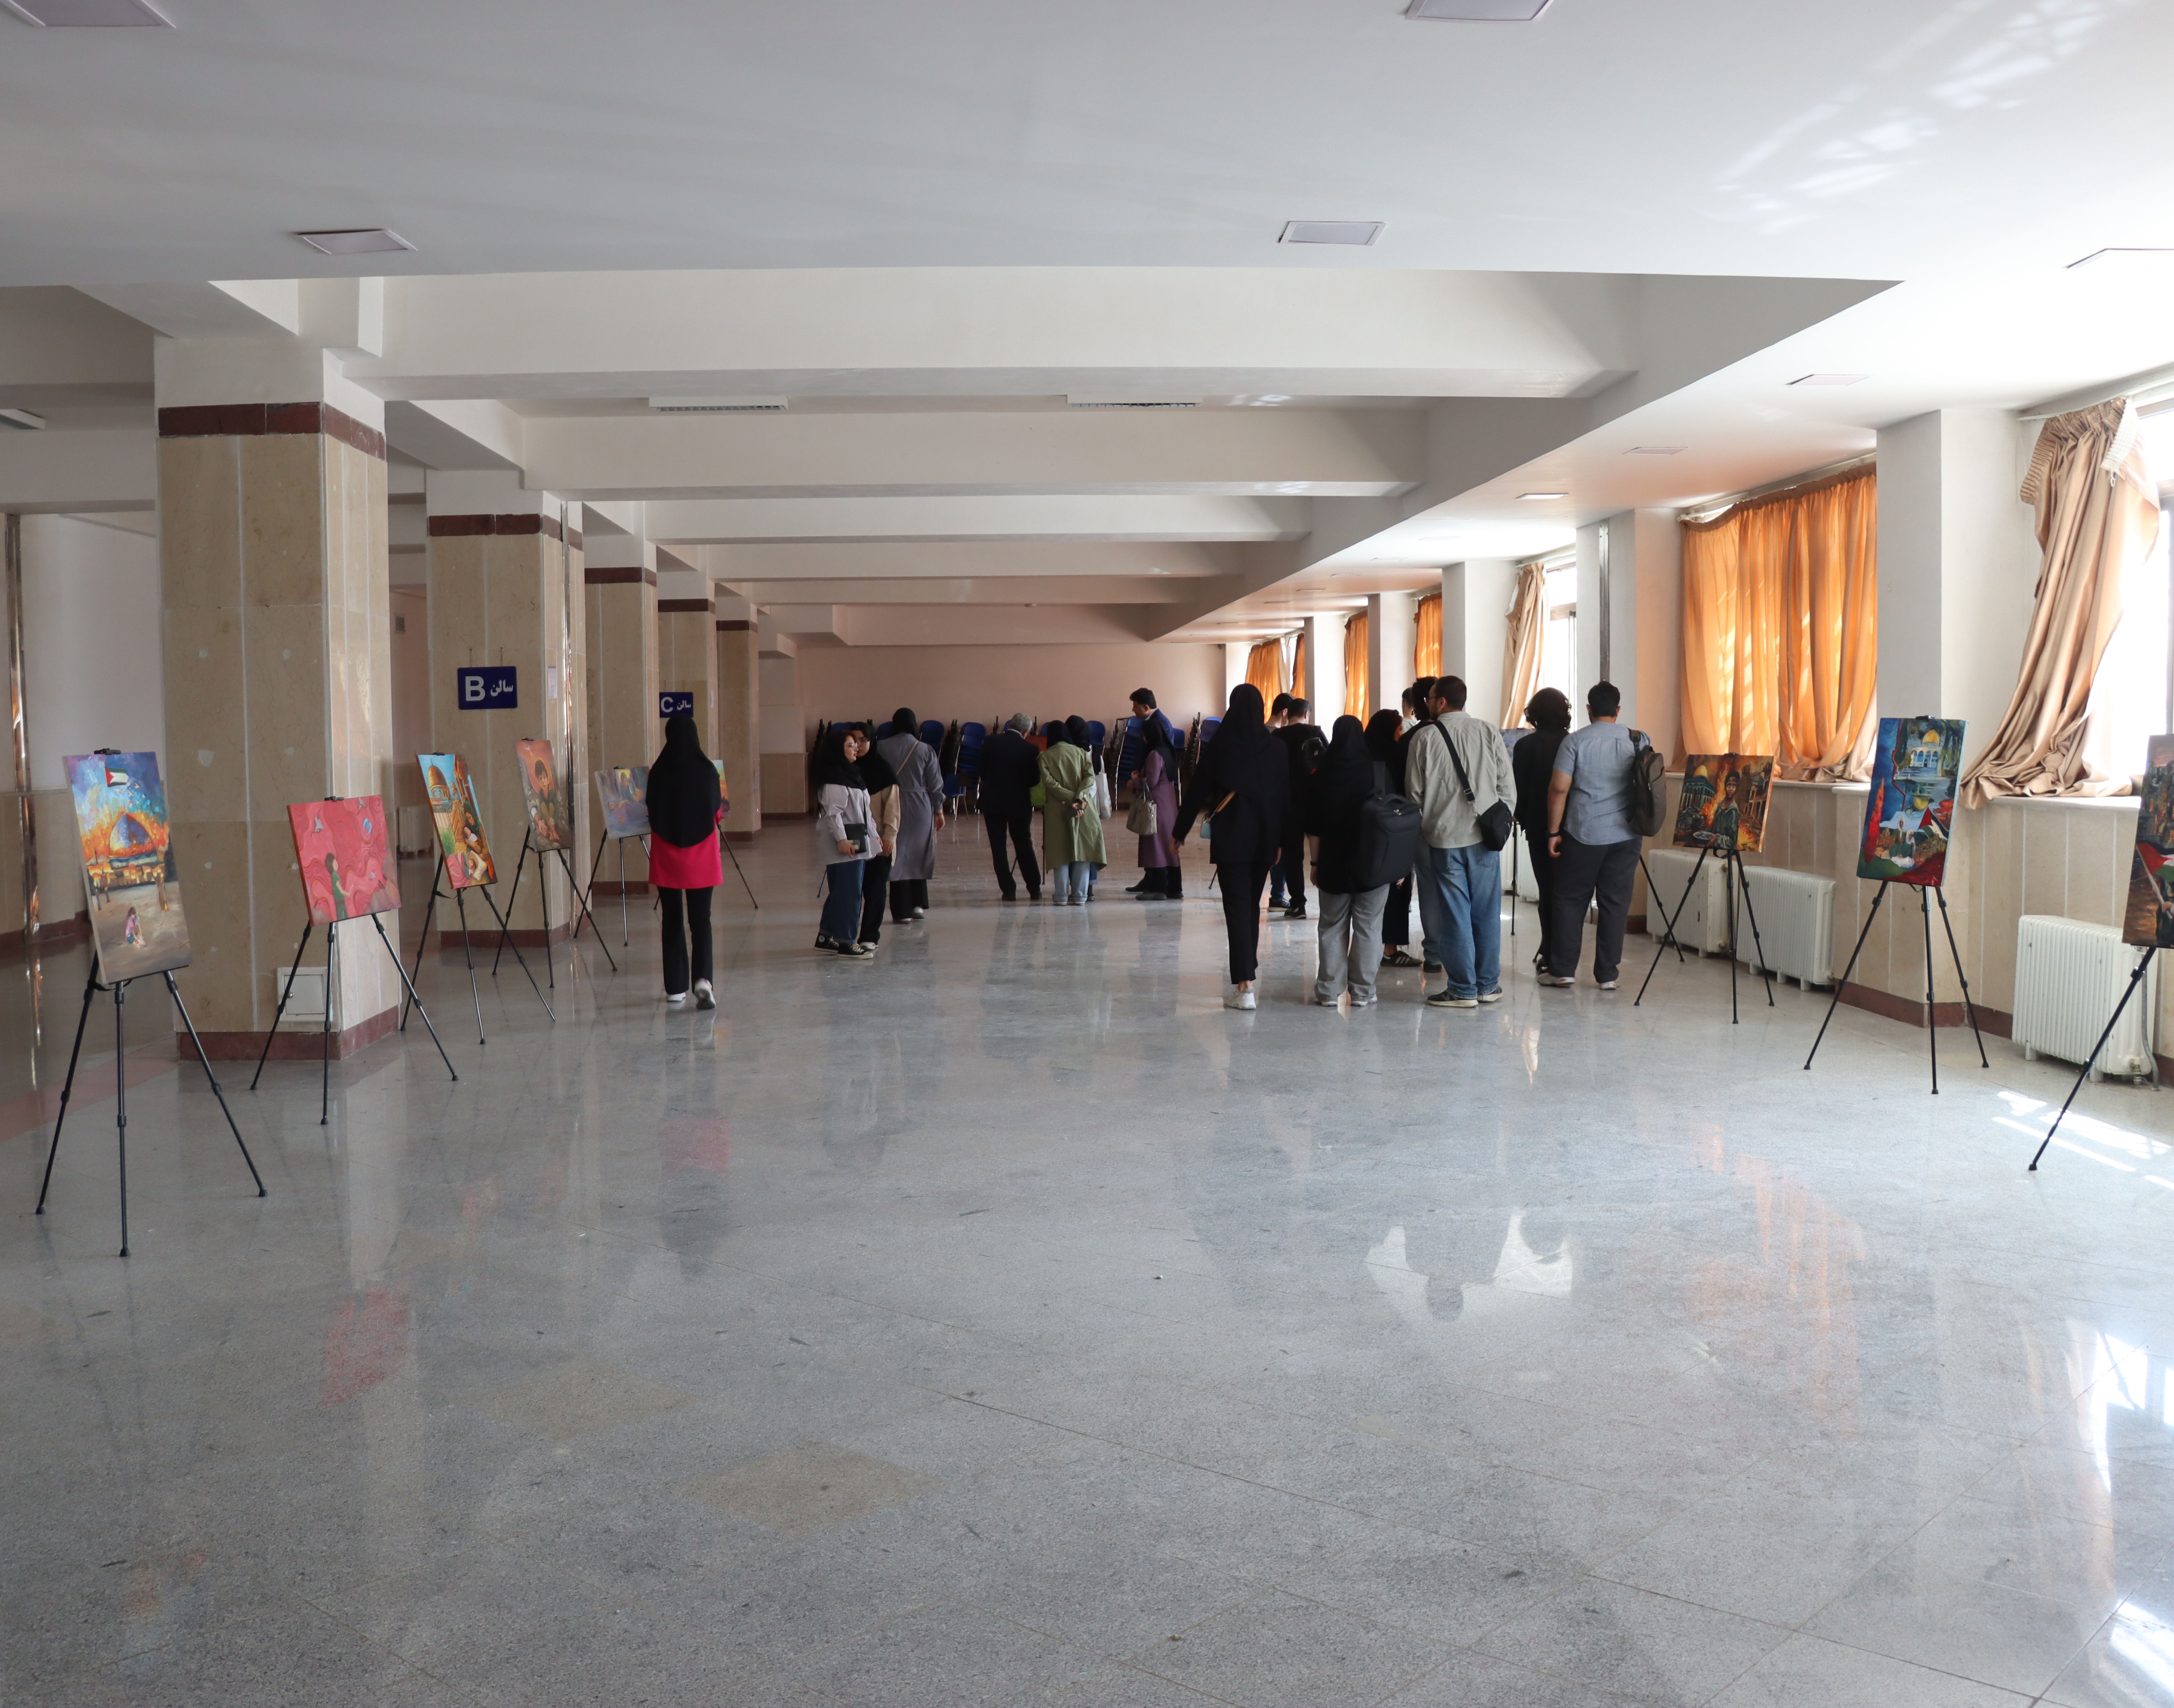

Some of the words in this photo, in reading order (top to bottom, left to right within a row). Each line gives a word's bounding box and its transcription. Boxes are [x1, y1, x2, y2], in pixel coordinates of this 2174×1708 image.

[465, 676, 486, 701] B
[490, 680, 513, 696] سالن
[661, 696, 673, 712] C
[677, 700, 691, 710] سالن
